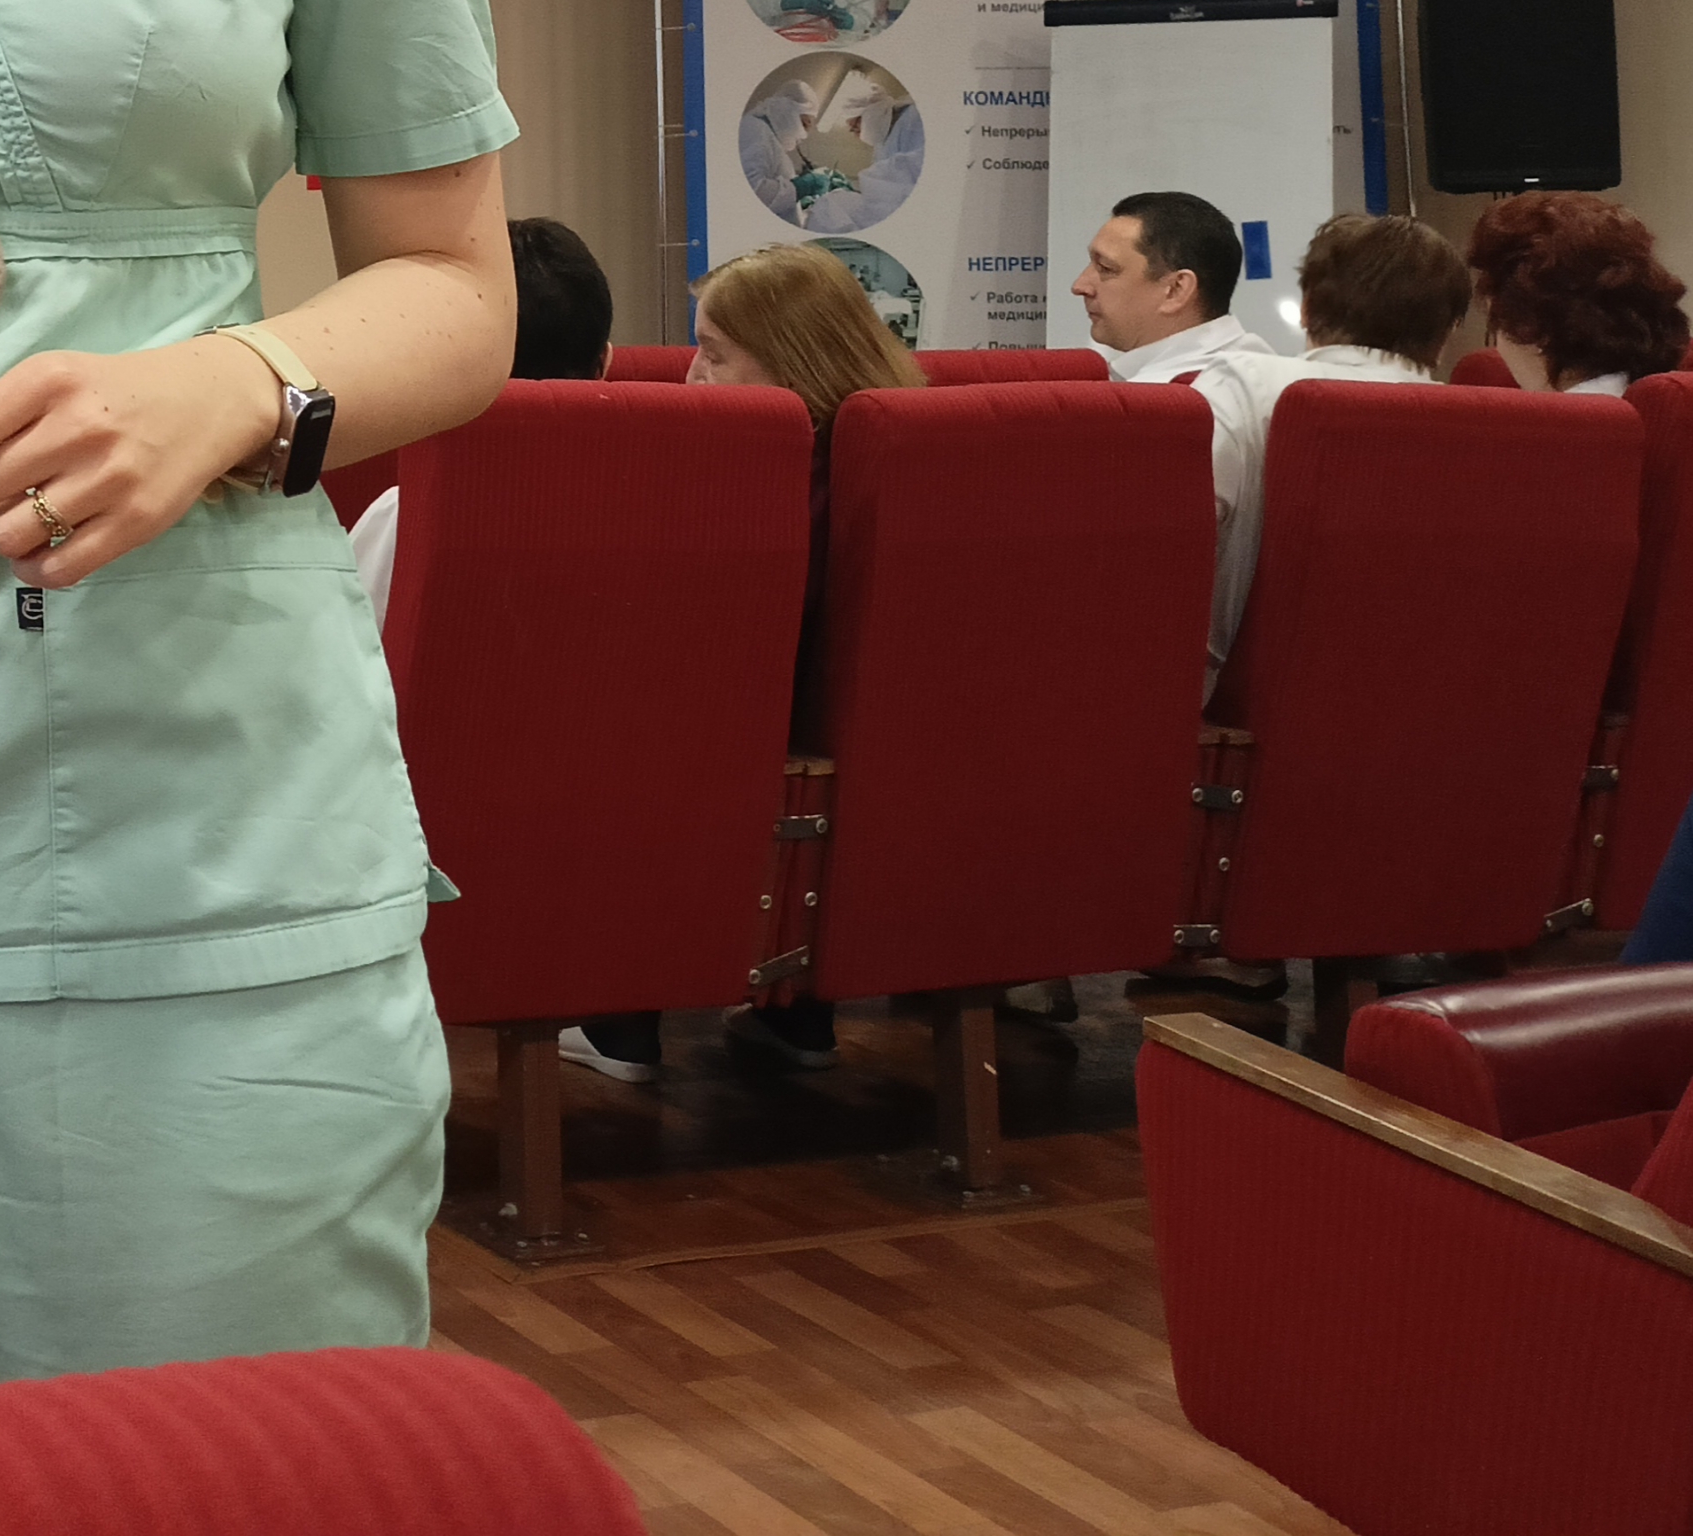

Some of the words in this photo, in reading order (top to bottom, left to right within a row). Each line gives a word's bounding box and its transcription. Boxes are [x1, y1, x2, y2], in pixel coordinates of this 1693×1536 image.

[977, 2, 987, 12] и
[981, 125, 1049, 140] Непреры
[967, 256, 1047, 272] НЕПРЕР
[986, 291, 1039, 304] Работа
[987, 310, 1047, 322] медици
